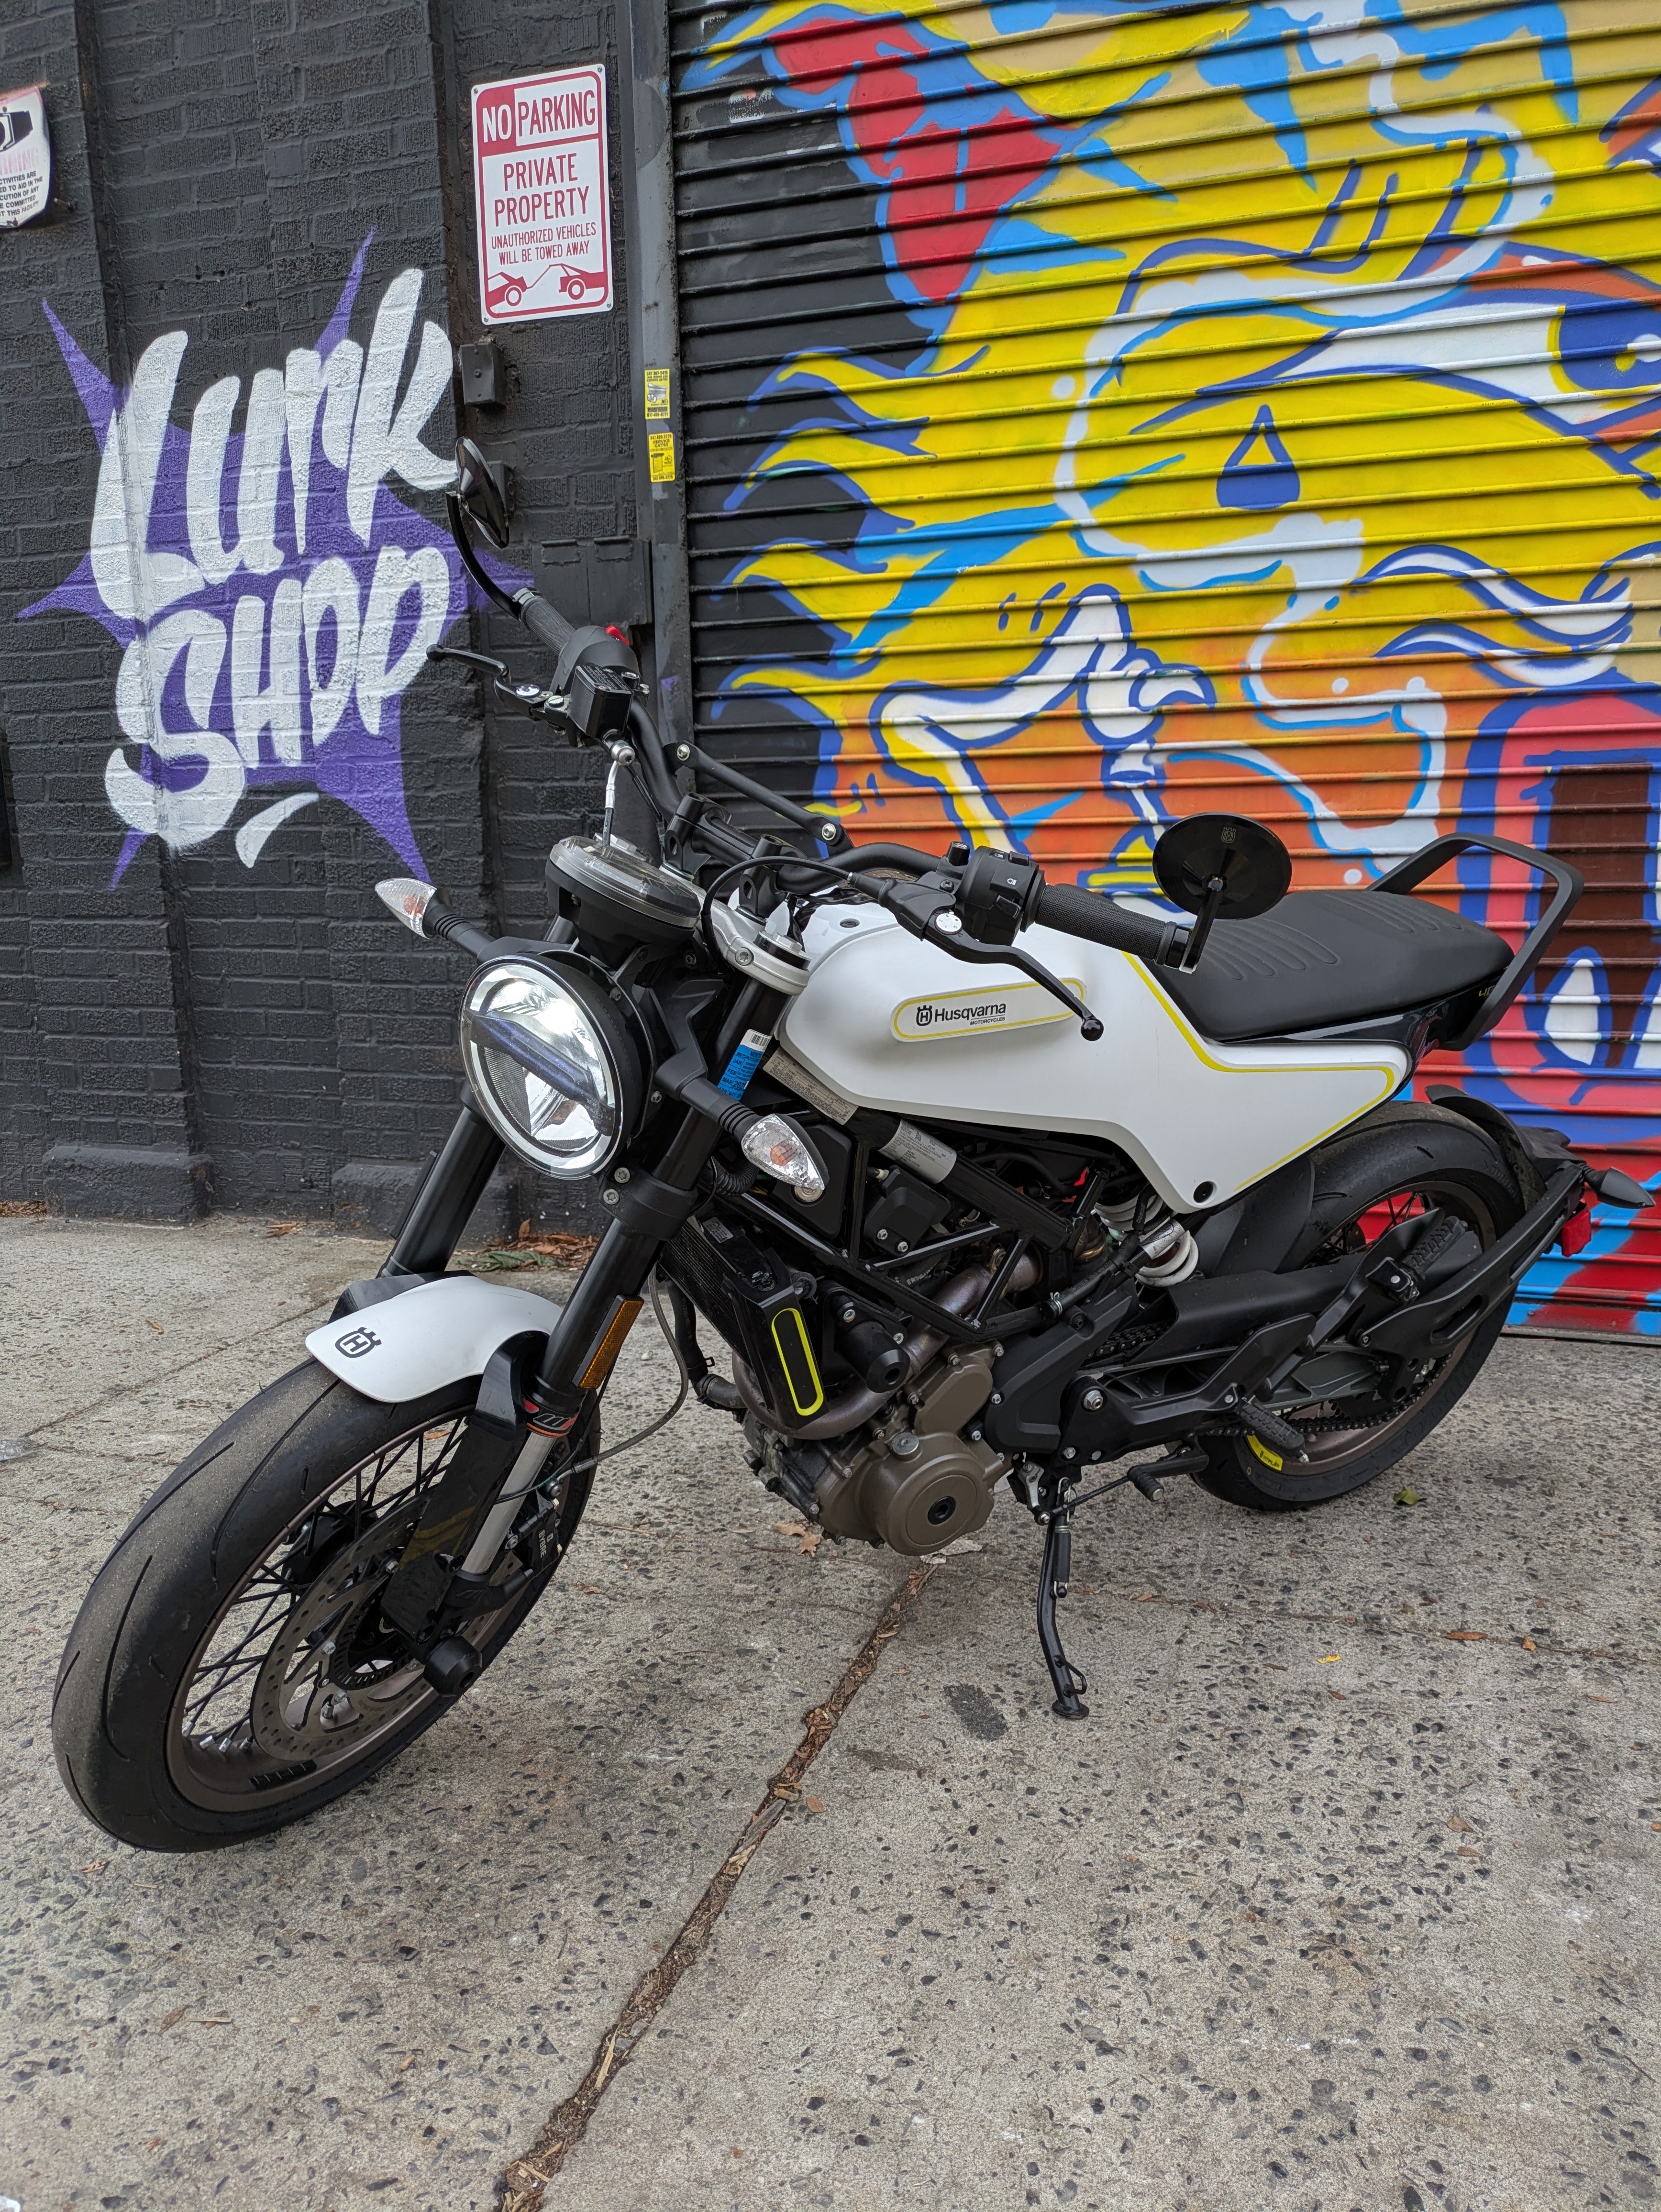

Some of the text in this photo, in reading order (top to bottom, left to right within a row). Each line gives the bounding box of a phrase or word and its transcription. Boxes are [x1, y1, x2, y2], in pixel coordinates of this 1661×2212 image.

[482, 90, 596, 143] NO PARKING
[27, 170, 36, 179] ARE
[503, 153, 578, 191] PRIVATE
[30, 185, 39, 194] ANY
[6, 195, 36, 208] COMMITTED
[22, 199, 39, 213] FACILITY
[494, 186, 589, 227] PROPERTY
[491, 222, 597, 249] UNAUTHORIZED VEHICLES
[499, 240, 589, 265] WILL BE TOWED AWAY
[934, 1003, 1006, 1022] Husqvarna
[970, 1017, 1005, 1025] MOTORCYCLES
[1263, 1455, 1280, 1468] VITPILEN
